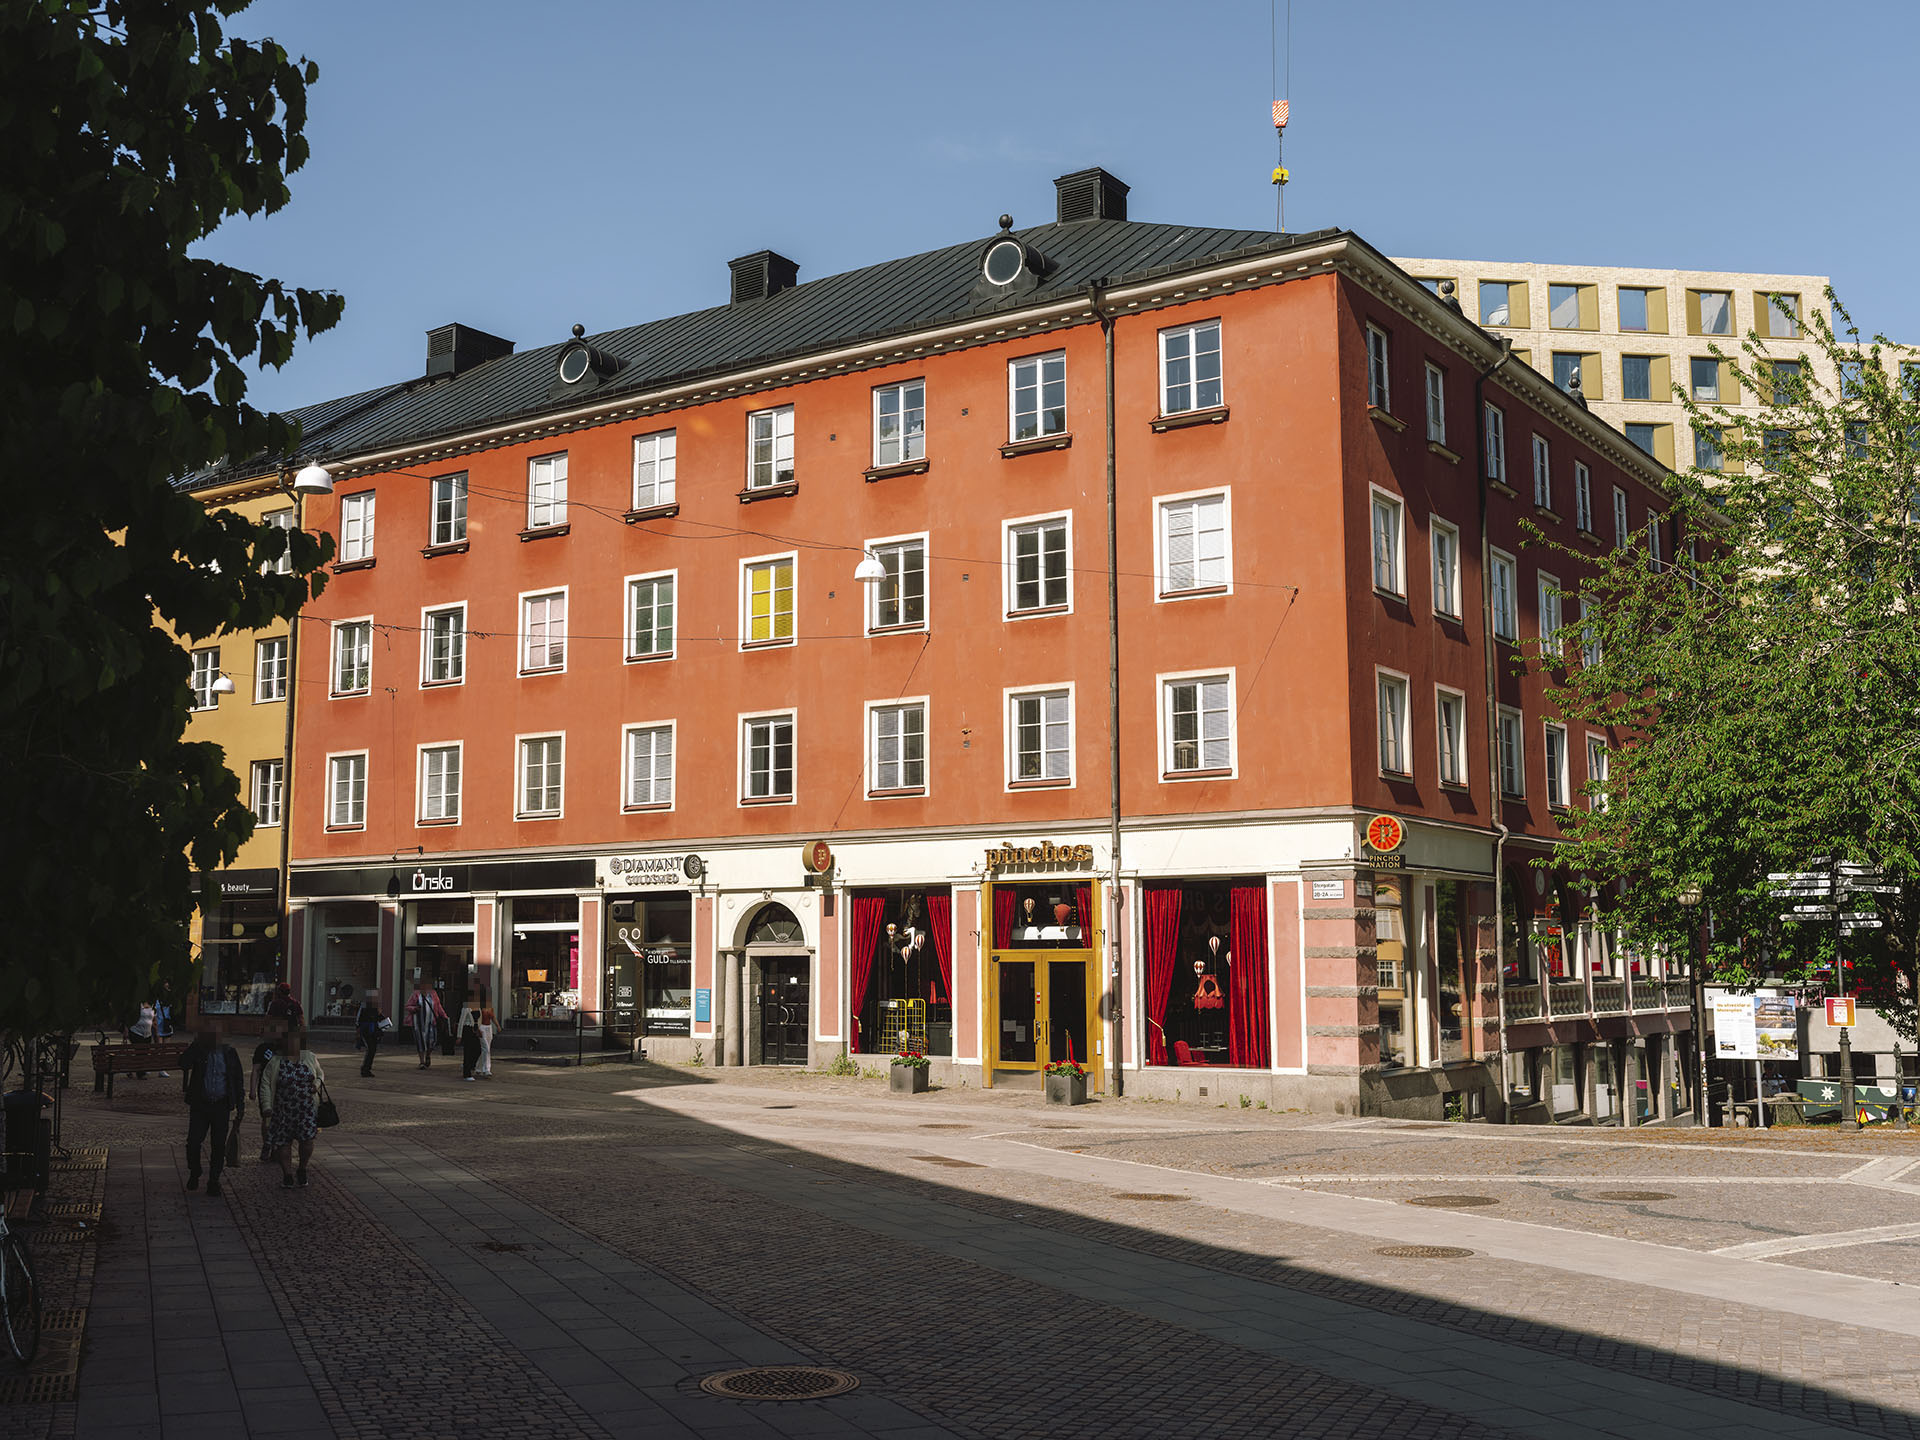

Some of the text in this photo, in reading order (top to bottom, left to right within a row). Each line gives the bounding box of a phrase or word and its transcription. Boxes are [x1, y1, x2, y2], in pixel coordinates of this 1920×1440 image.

[984, 840, 1092, 871] pinchos
[621, 857, 682, 874] DIAMANT
[625, 873, 680, 886] GULDSMED
[227, 882, 250, 894] beauty
[647, 954, 670, 964] GULD
